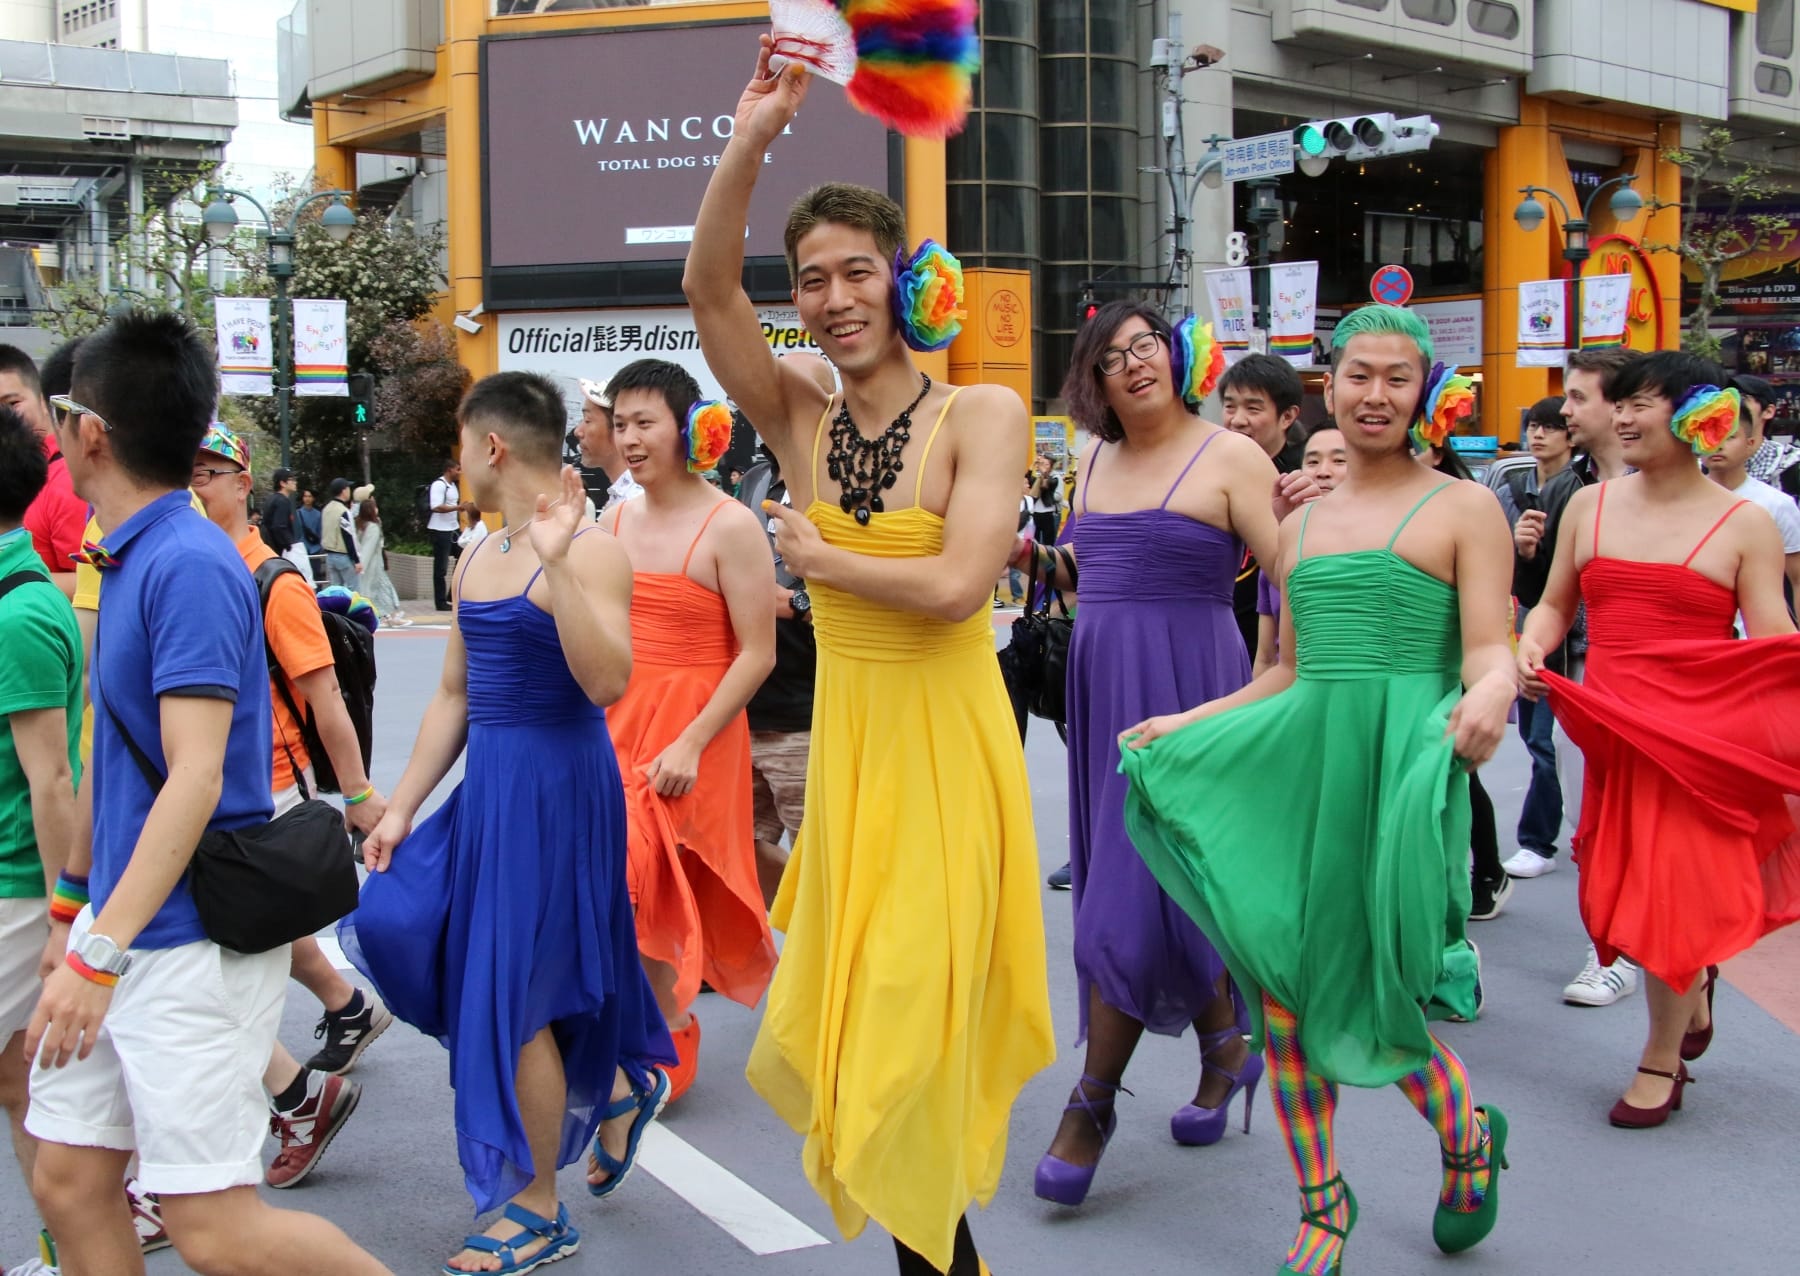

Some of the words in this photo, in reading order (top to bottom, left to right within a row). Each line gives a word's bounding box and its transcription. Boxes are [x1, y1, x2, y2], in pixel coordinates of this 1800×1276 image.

[573, 112, 798, 145] WANCO
[1225, 138, 1289, 163] 神南郵便局前
[598, 159, 650, 171] TOTAL
[657, 156, 696, 169] DOG
[1225, 166, 1249, 176] Jin-nan
[1251, 161, 1267, 172] Post
[1269, 158, 1290, 170] Office
[641, 229, 694, 241] ワンコッ
[1226, 231, 1249, 266] 8
[1605, 254, 1632, 275] NO
[1728, 286, 1762, 294] Blu-ray
[1764, 285, 1772, 293] &
[1000, 294, 1011, 303] NO
[993, 303, 1019, 314] MUSIC
[1000, 314, 1011, 323] NO
[996, 324, 1014, 334] LIFE
[1222, 319, 1246, 331] PRIDE
